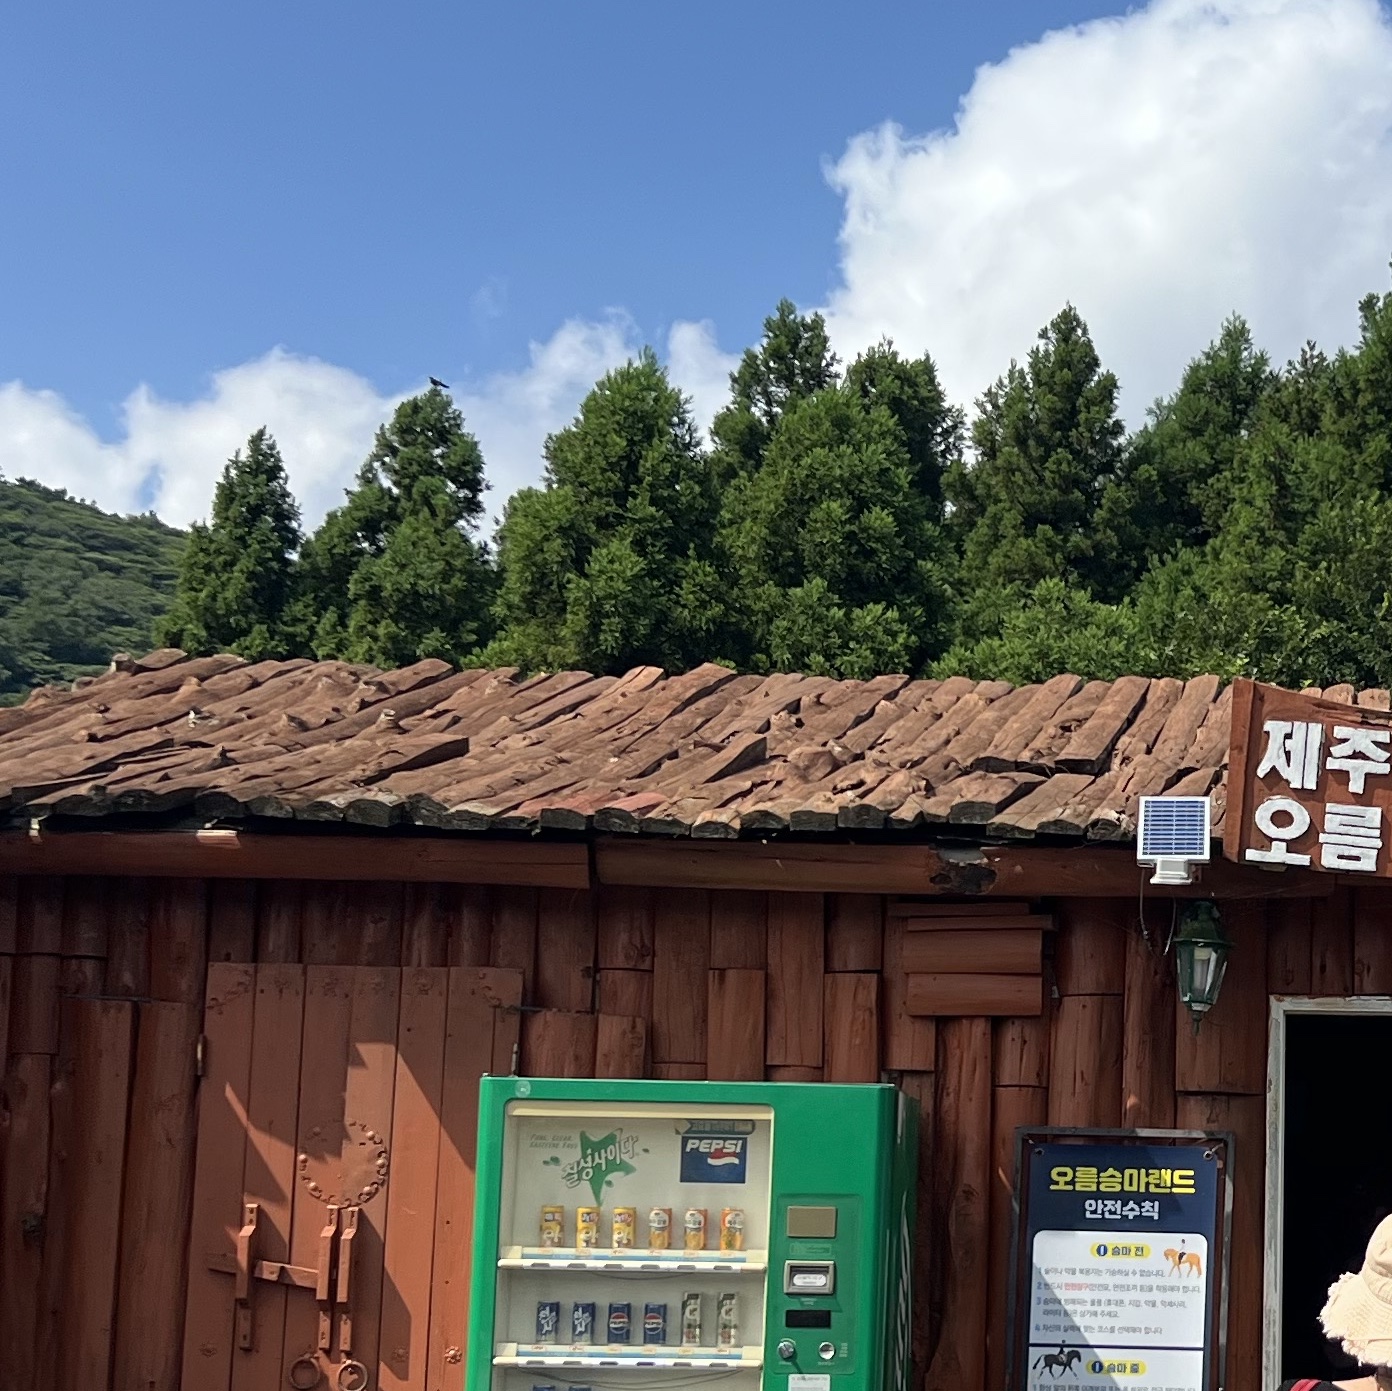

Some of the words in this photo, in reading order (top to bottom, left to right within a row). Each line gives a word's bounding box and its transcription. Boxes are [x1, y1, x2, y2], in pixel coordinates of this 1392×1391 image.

[1255, 719, 1392, 795] 제주
[1244, 795, 1383, 872] 오름
[685, 1139, 743, 1154] PEPSI
[561, 1134, 640, 1189] 칠성사이다
[1049, 1166, 1196, 1194] 오름승마랜드
[1084, 1199, 1160, 1220] 안전수칙
[1111, 1246, 1131, 1257] 승마
